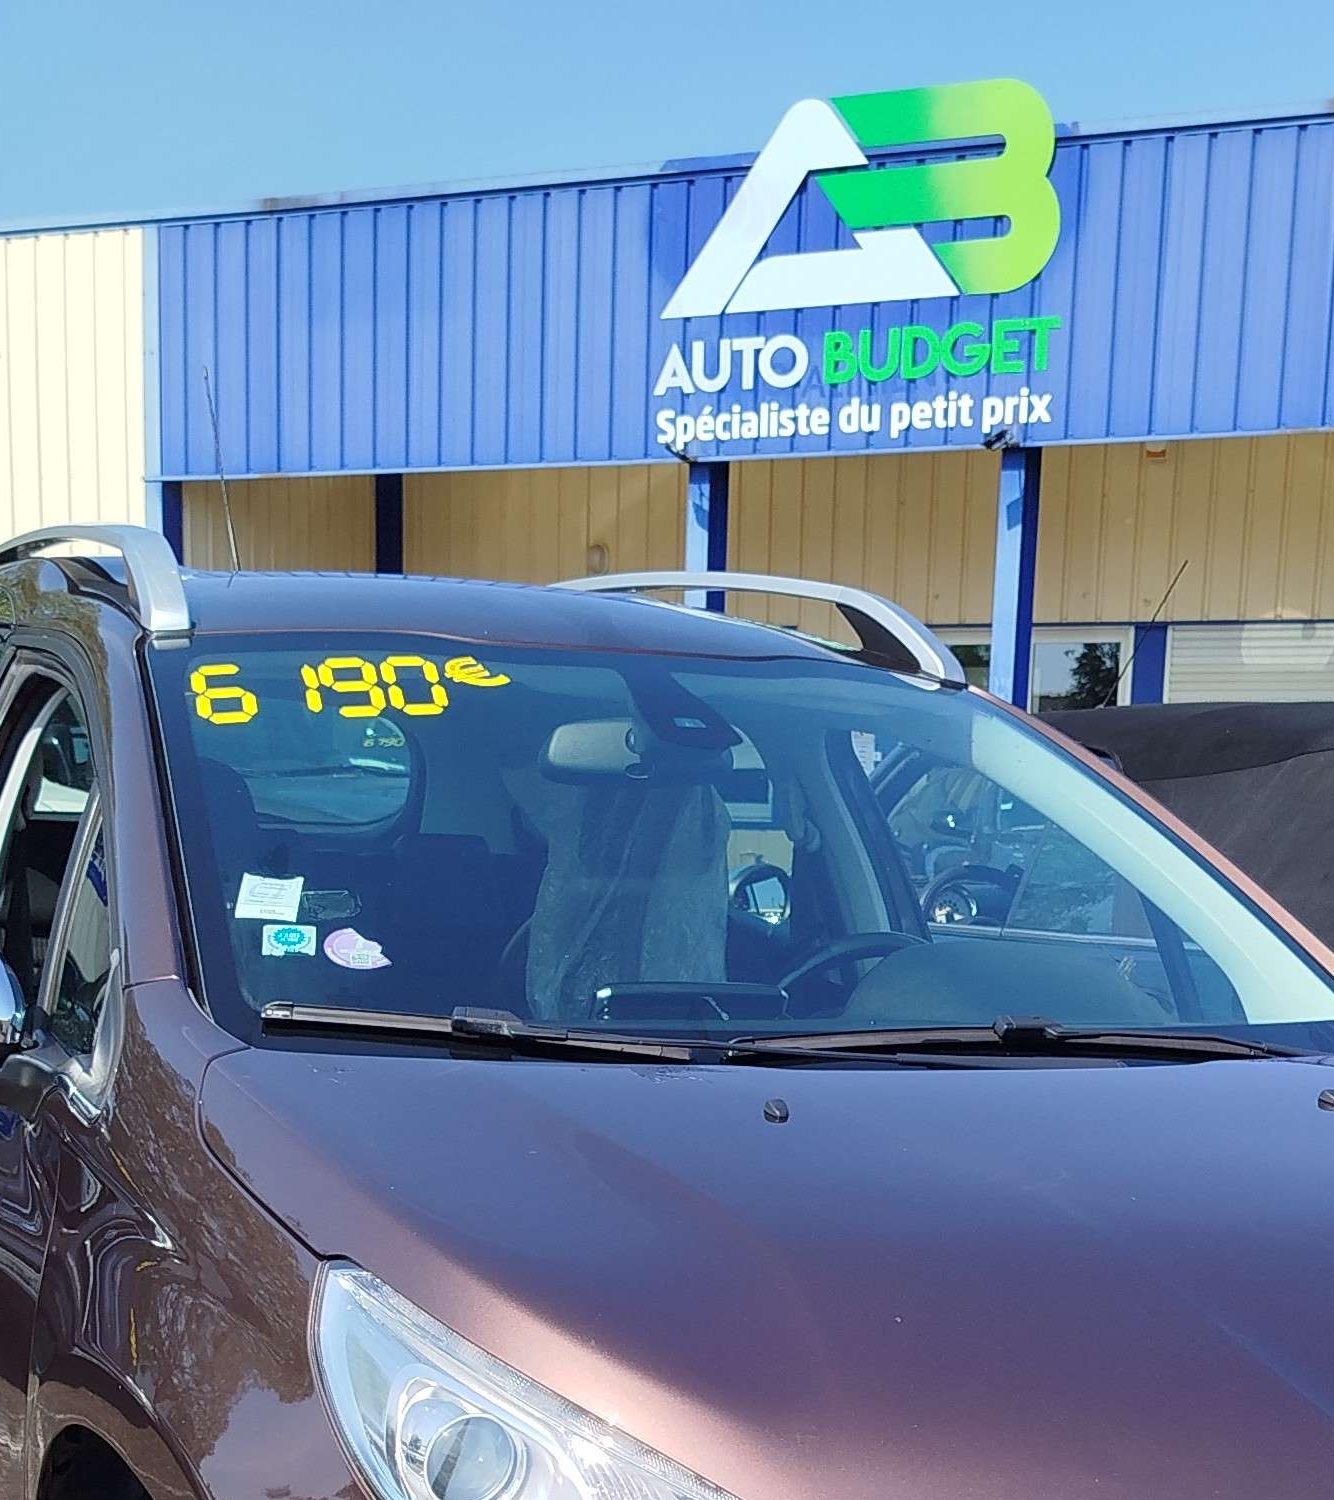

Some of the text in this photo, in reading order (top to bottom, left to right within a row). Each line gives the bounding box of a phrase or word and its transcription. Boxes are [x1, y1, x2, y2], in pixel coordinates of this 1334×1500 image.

[653, 333, 809, 397] AUTO
[823, 316, 1063, 385] BUDGET
[655, 385, 1053, 451] Spécialiste du petit prix
[190, 664, 259, 725] 6
